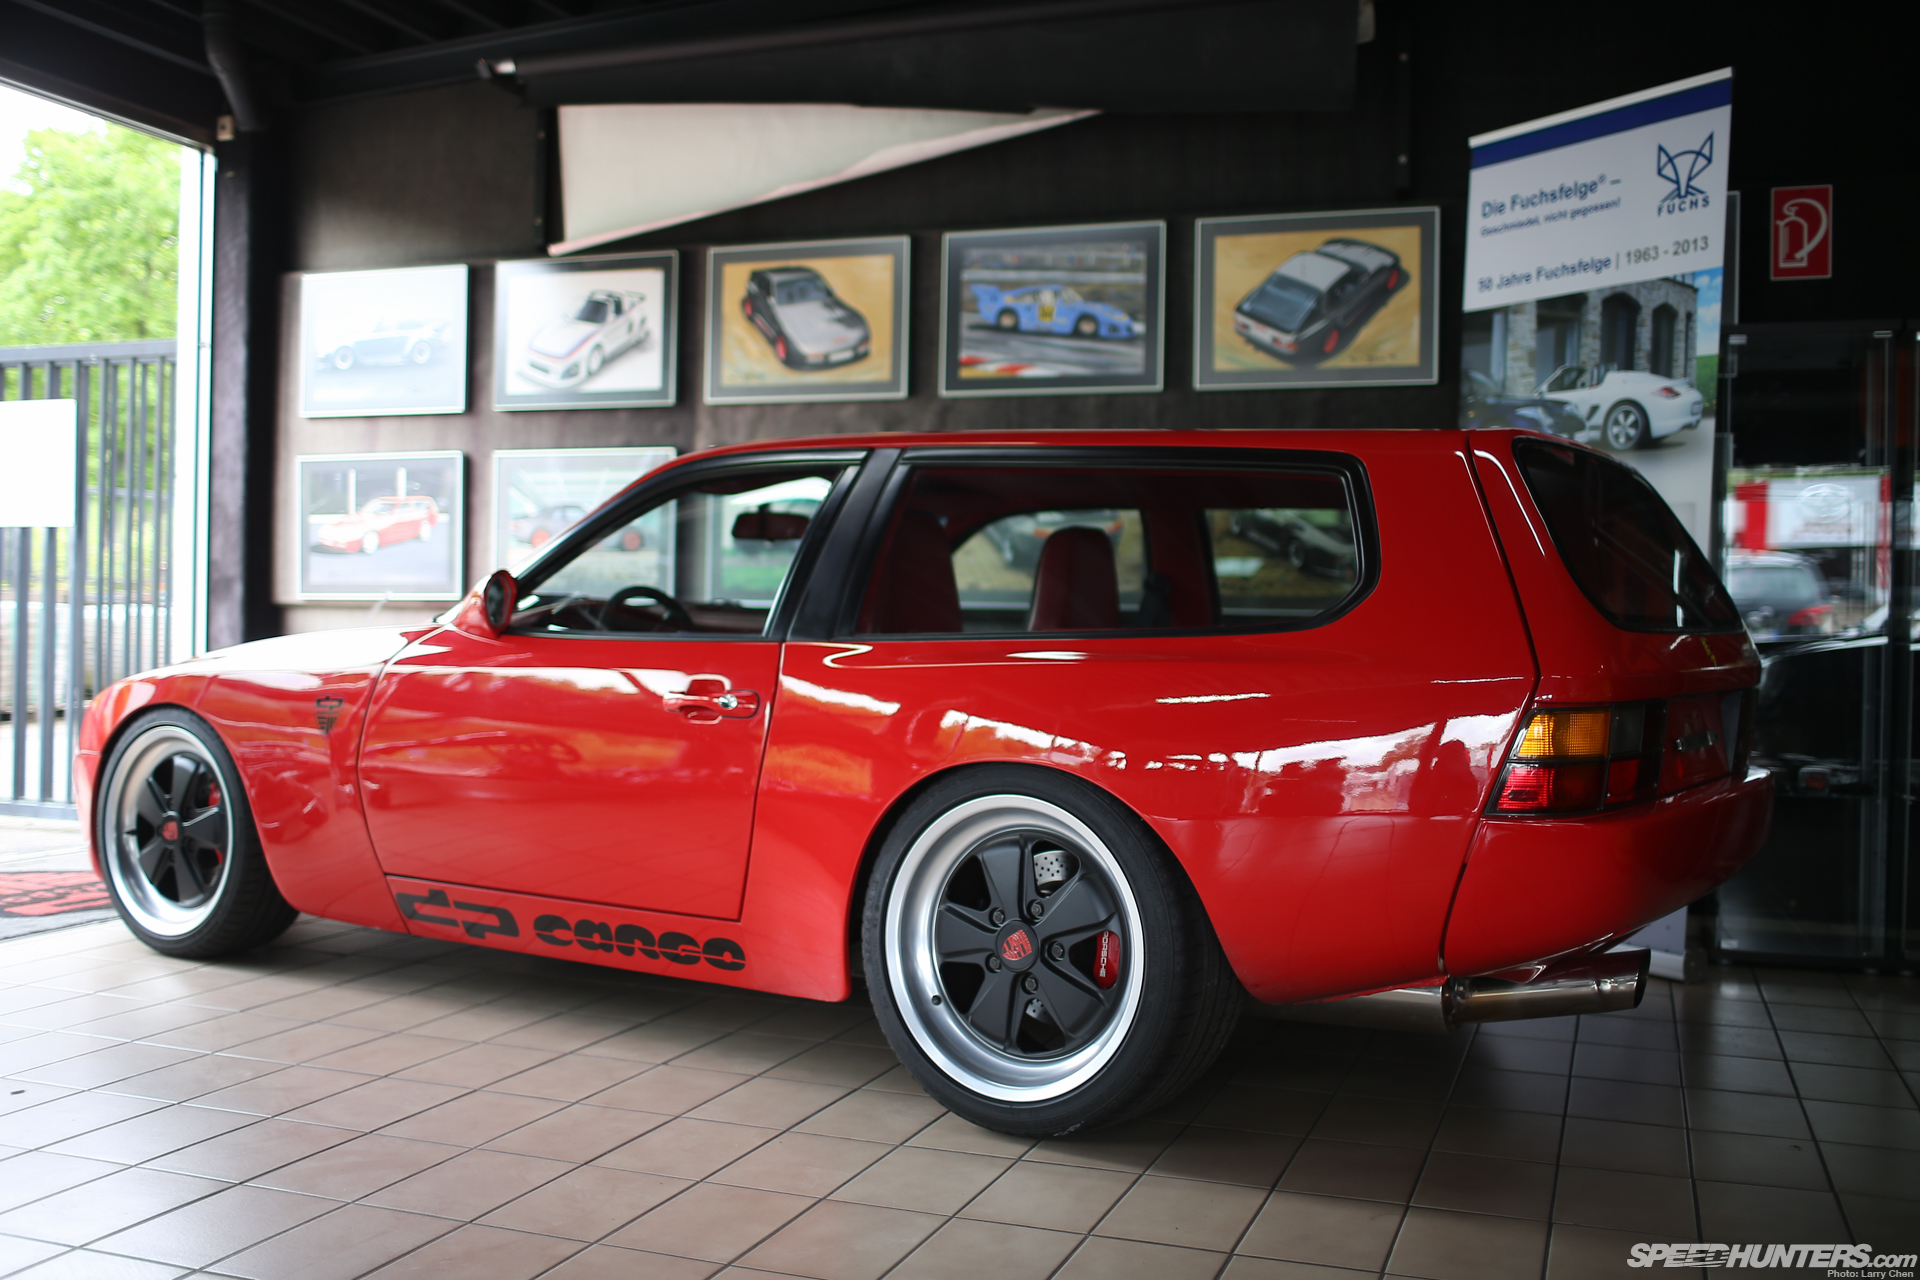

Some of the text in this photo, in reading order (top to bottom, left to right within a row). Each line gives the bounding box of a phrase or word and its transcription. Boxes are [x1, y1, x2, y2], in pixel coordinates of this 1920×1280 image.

[1481, 199, 1506, 219] Die
[1544, 209, 1568, 223] nicht
[1657, 195, 1710, 217] FUCHS
[1478, 277, 1494, 293] 50
[1496, 272, 1532, 289] Jahre
[1536, 256, 1611, 283] Fuchsfelge
[1625, 245, 1659, 266] 1963
[1673, 236, 1710, 256] 2013
[1100, 930, 1109, 977] PORSCHE
